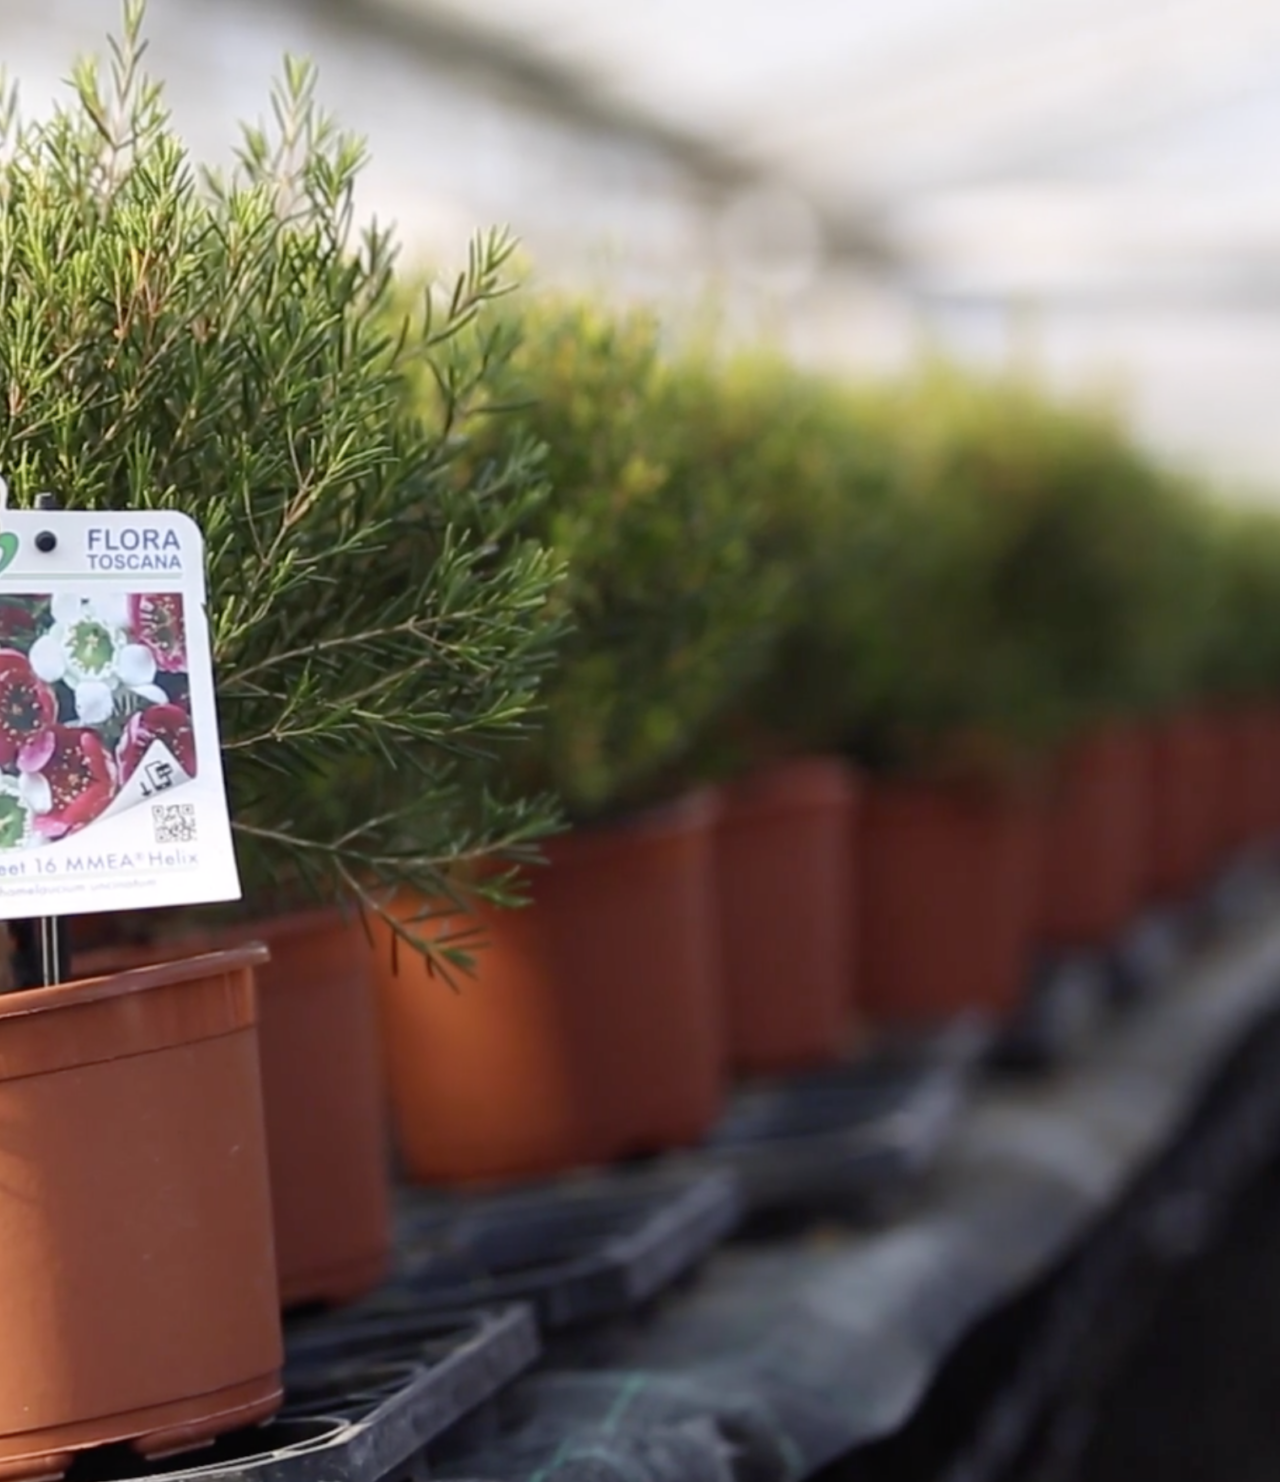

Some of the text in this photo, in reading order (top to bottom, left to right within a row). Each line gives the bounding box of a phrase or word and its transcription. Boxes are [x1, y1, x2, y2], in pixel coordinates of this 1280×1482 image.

[88, 529, 180, 550] FLORA
[87, 554, 182, 570] TOSCANA
[35, 858, 57, 874] 16
[148, 849, 199, 866] Helix
